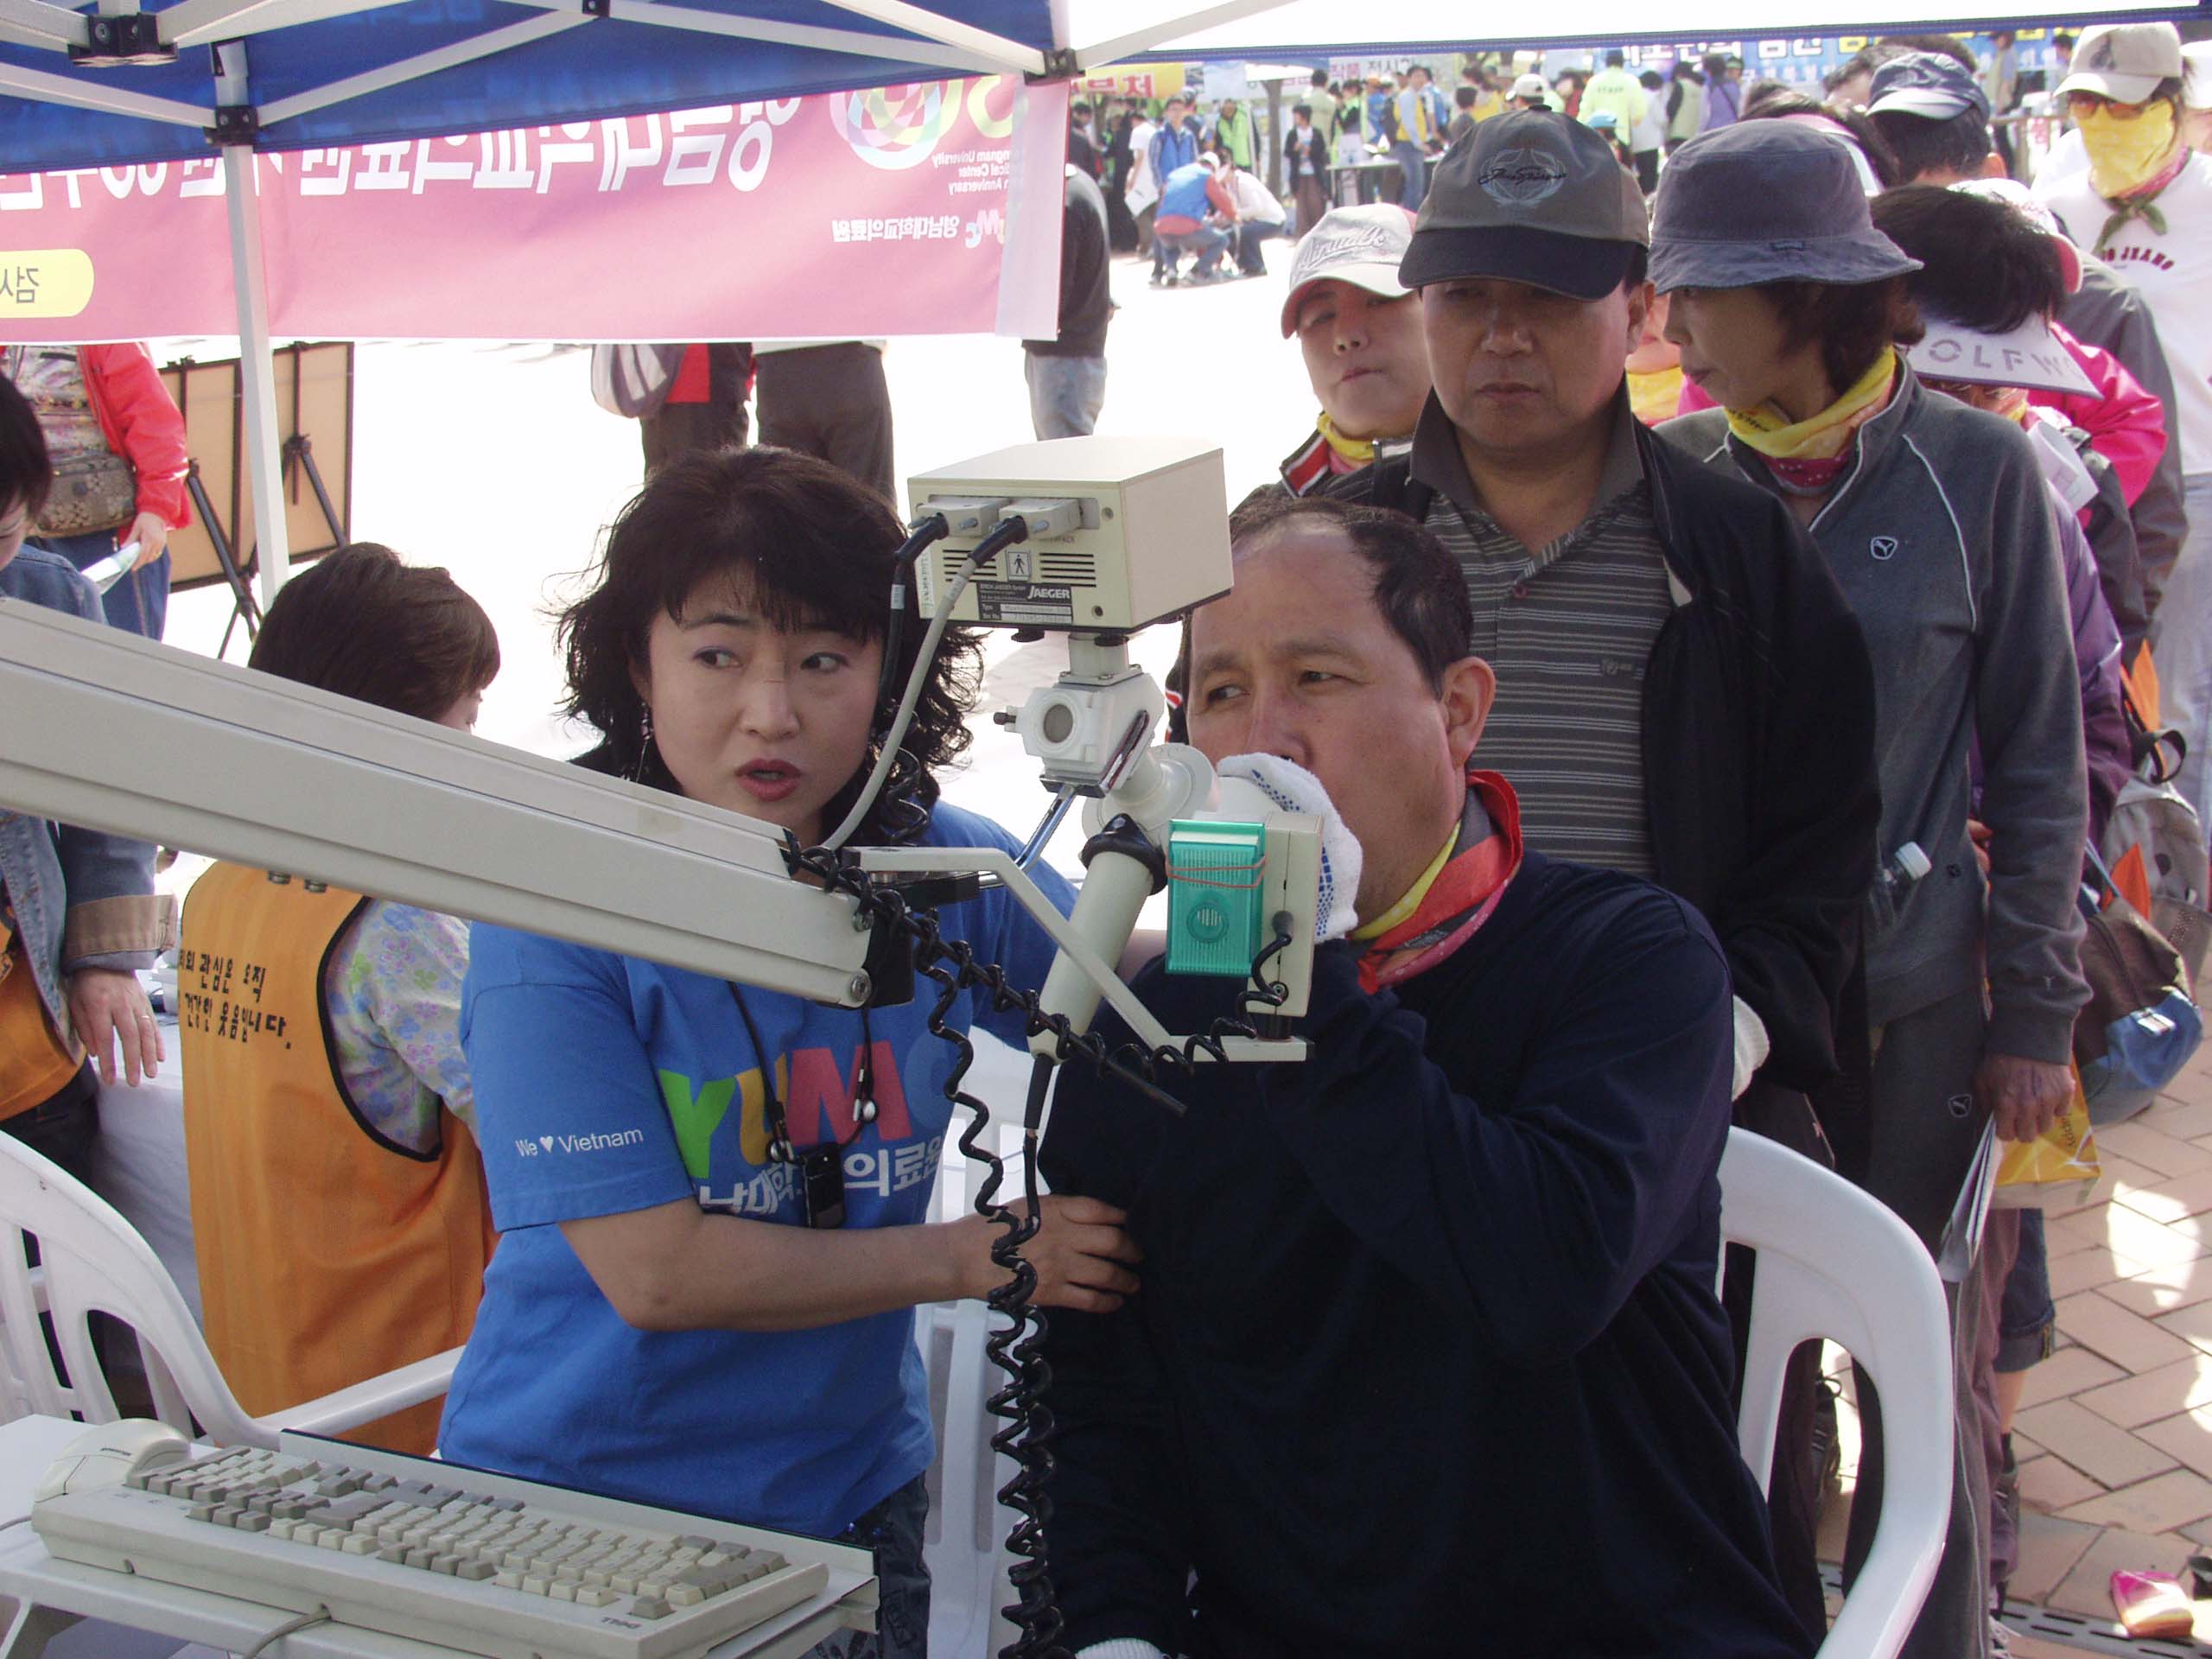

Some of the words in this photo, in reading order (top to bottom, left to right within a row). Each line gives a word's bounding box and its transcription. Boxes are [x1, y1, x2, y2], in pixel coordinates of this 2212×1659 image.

[1027, 585, 1071, 600] JAEGER
[200, 953, 234, 994] 관심은
[515, 1138, 537, 1158] We
[557, 1126, 644, 1154] Vietnam
